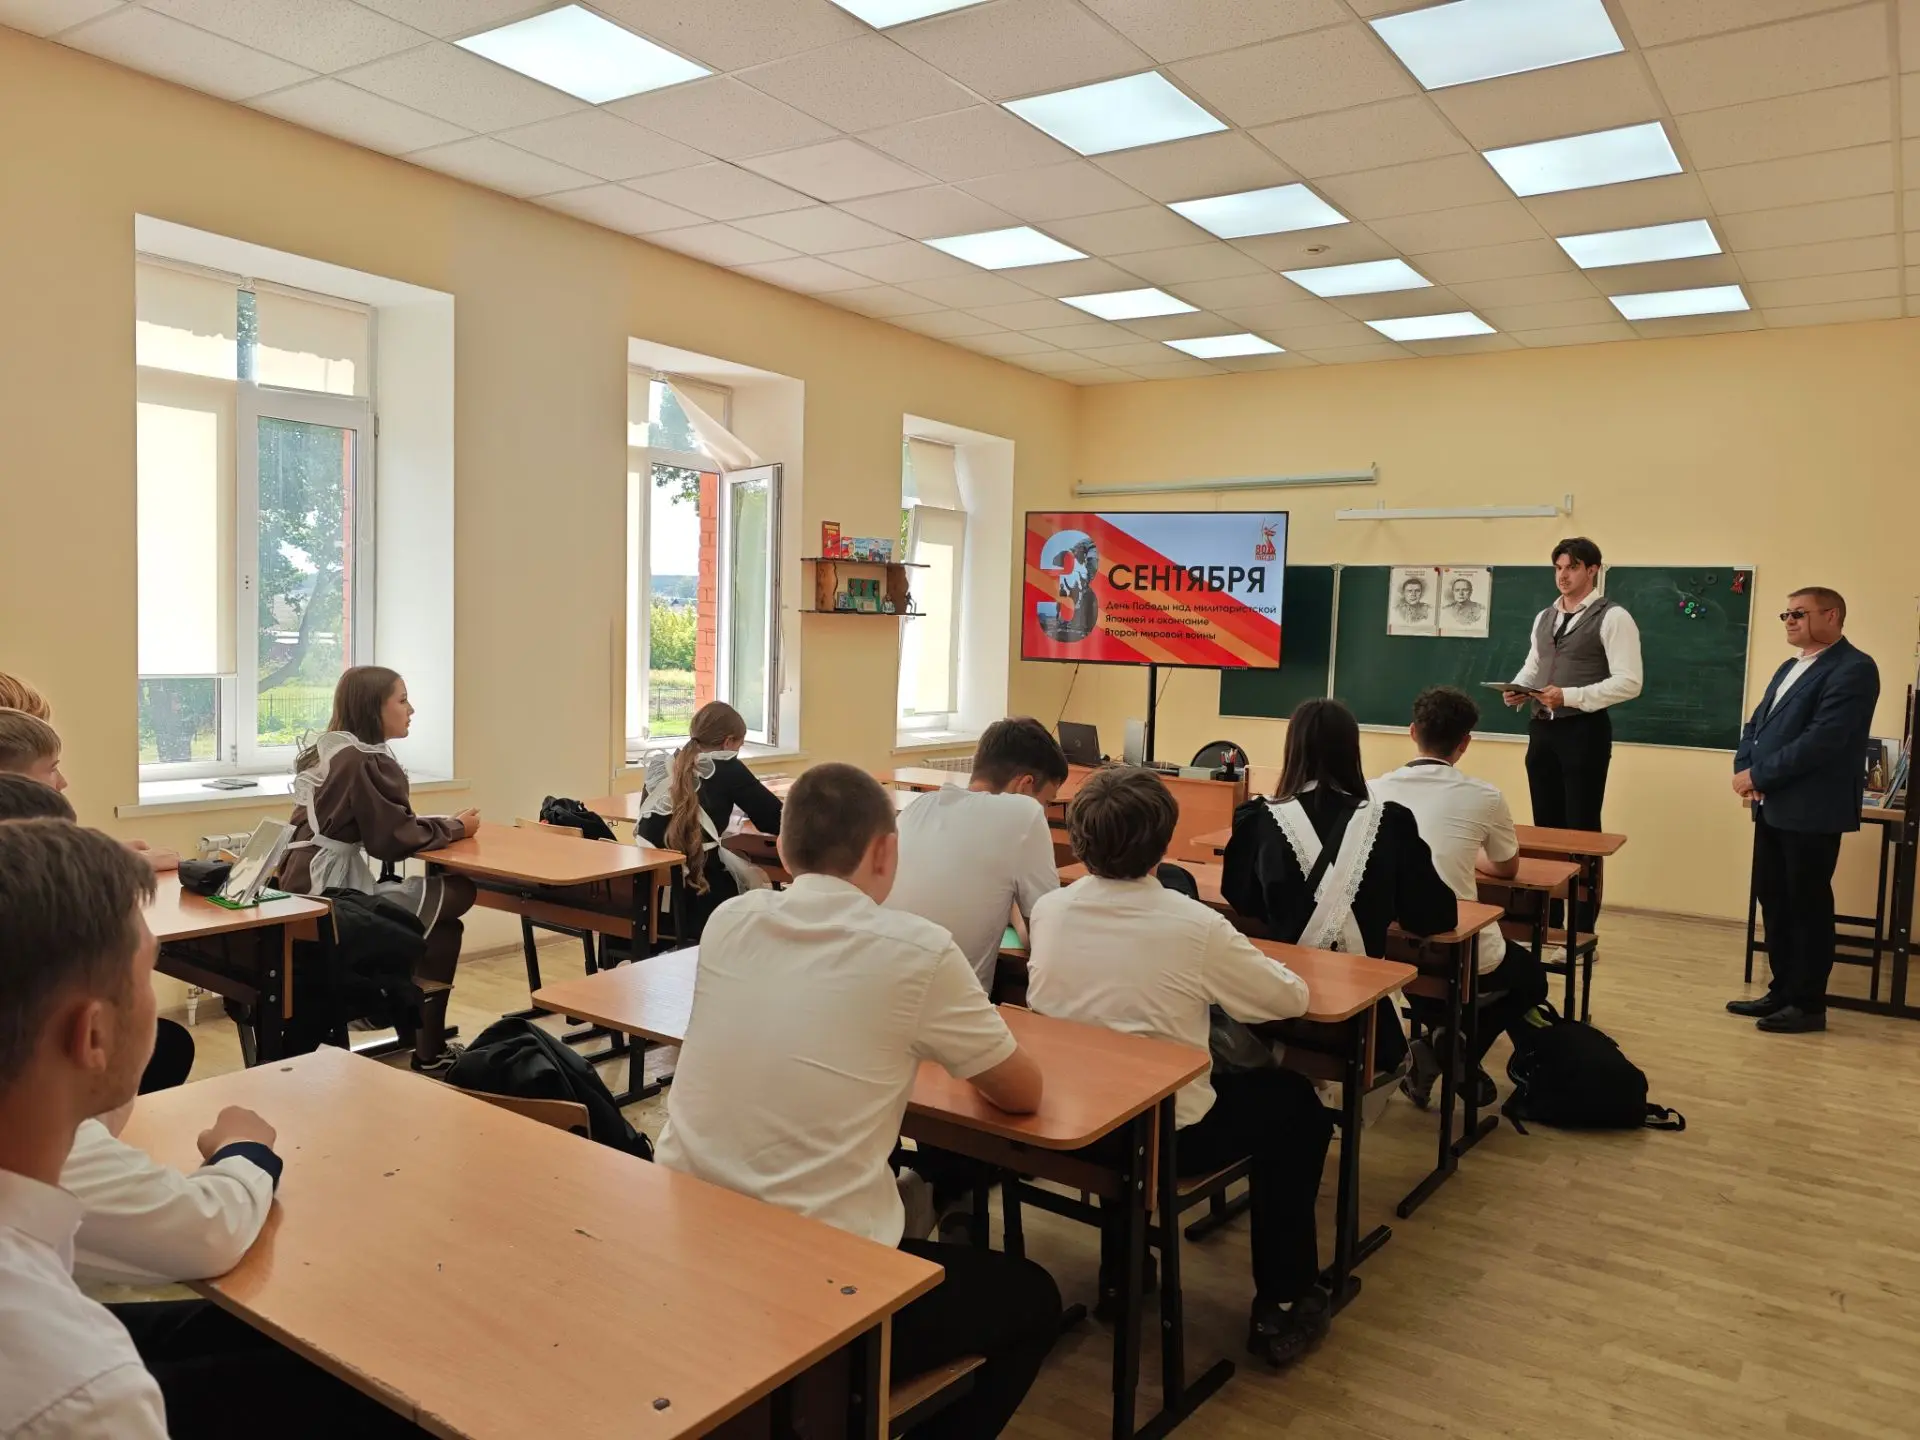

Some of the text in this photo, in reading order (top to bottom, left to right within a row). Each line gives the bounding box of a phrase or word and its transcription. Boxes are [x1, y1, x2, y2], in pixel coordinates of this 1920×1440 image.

[1036, 530, 1266, 643] 3 СЕНТЯБРЯ
[1105, 601, 1277, 614] День Победы над милитаристской
[1105, 614, 1145, 624] Японией
[1157, 617, 1209, 626] окончание
[1105, 628, 1216, 640] Второй мировой войны
